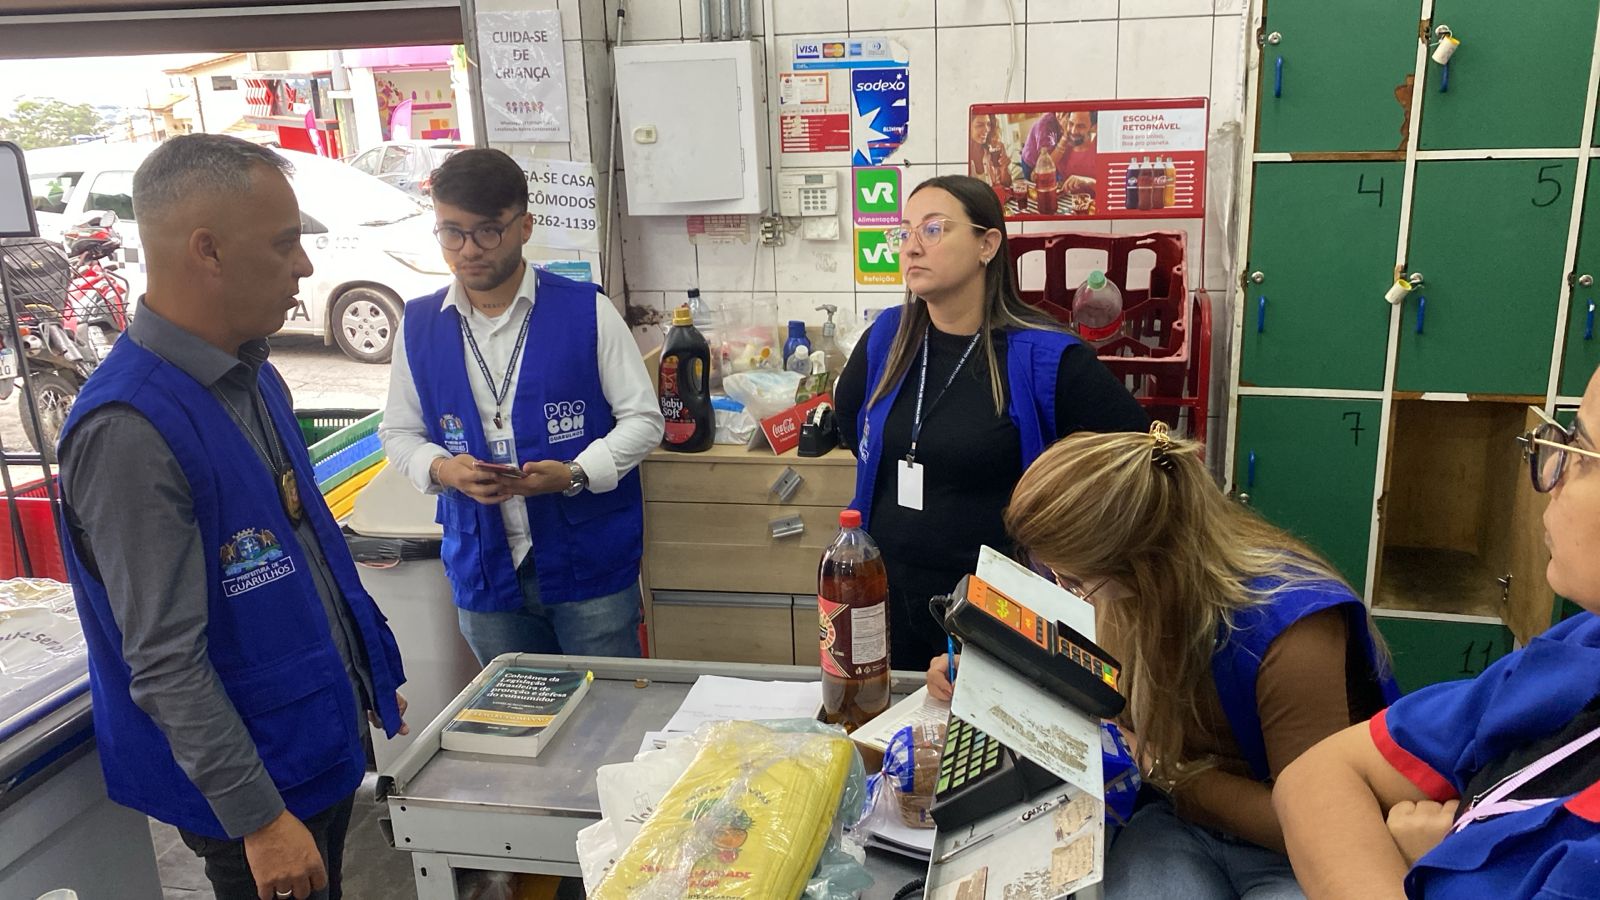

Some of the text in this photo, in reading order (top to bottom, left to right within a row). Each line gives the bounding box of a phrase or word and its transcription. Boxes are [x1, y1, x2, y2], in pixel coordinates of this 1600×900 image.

[492, 30, 548, 43] CUIDA-SE
[513, 49, 529, 60] DE
[800, 45, 818, 53] VISA
[495, 66, 550, 81] CRIANÇA
[856, 80, 906, 92] sodexo
[1122, 122, 1180, 131] RETORNÁVEL
[562, 173, 595, 188] CASA
[1531, 164, 1563, 208] 5
[1358, 174, 1384, 208] 4
[528, 190, 596, 209] CÔMODOS
[662, 396, 682, 410] Baby
[544, 400, 586, 420] PRO
[662, 408, 680, 418] Soft
[547, 414, 584, 434] CON
[1342, 412, 1365, 446] 7
[229, 564, 290, 594] GUARULHOS
[500, 678, 546, 686] Legislação
[504, 672, 548, 682] Coletânea
[490, 688, 530, 696] proteção
[496, 682, 538, 691] Brasileira
[500, 694, 556, 702] consumidor
[1022, 802, 1052, 821] CAIXA
